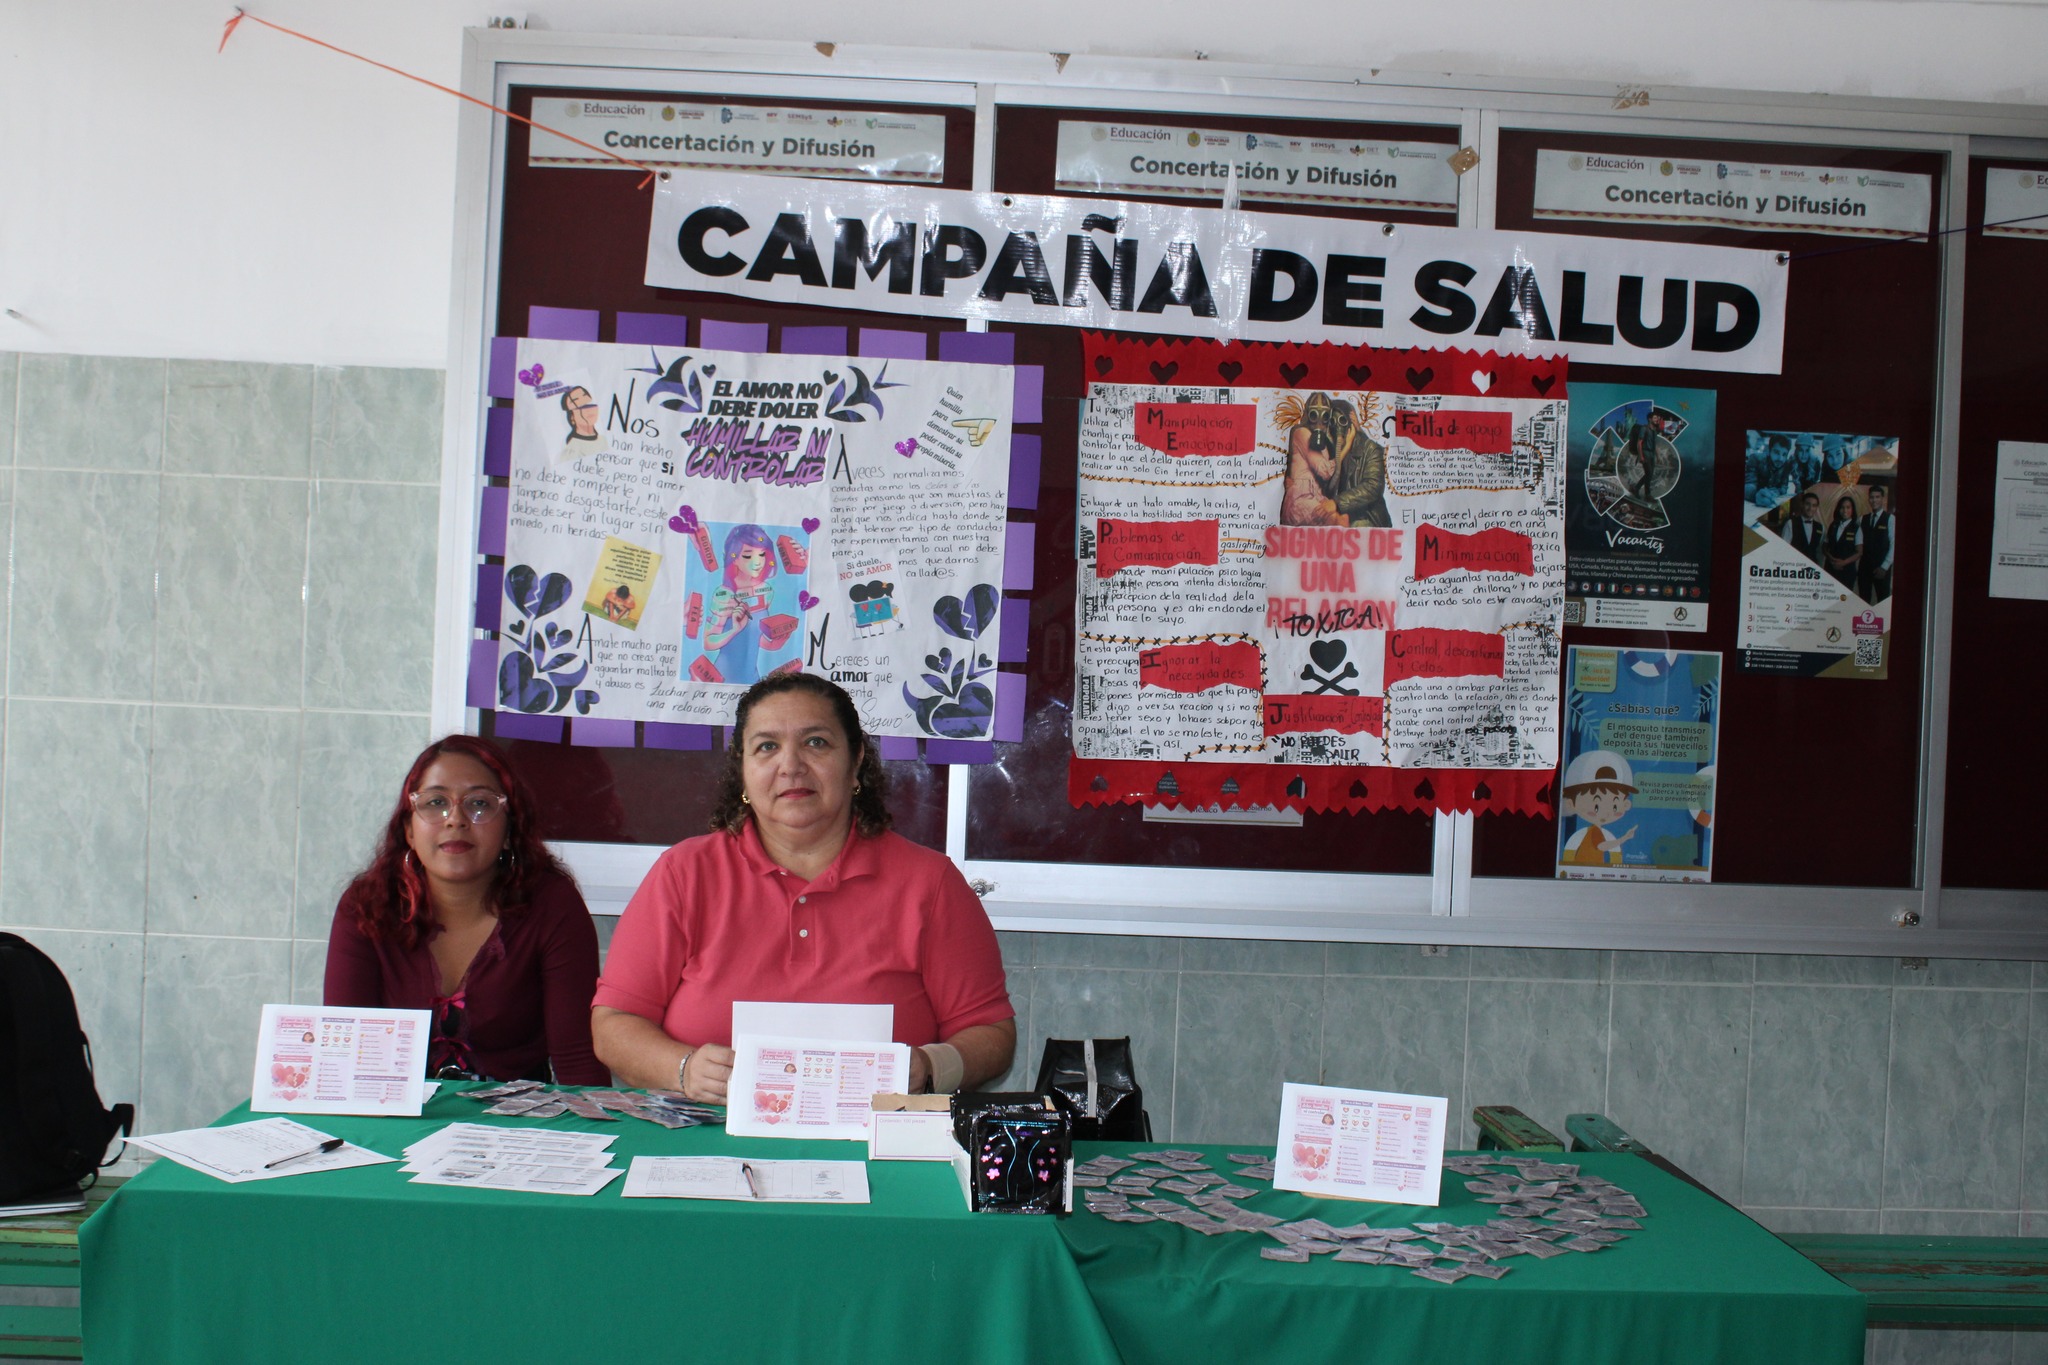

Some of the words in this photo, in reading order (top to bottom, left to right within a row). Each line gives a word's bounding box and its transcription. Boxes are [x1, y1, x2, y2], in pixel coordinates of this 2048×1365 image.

[584, 103, 645, 115] Educación
[1110, 127, 1171, 140] Educación
[604, 130, 754, 154] Concertación
[762, 140, 775, 158] y
[782, 137, 875, 158] Difusión
[1586, 156, 1644, 170] Educación
[1130, 155, 1279, 181] Concertación
[1286, 169, 1299, 185] y
[1307, 166, 1397, 188] Difusión
[1605, 185, 1748, 210] Concertación
[1755, 198, 1768, 214] y
[1775, 195, 1866, 217] Difusión
[677, 205, 1219, 319] CAMPAÑA
[1248, 248, 1386, 330] DE
[1409, 258, 1761, 353] SALUD
[713, 381, 733, 396] EL
[736, 382, 794, 398] AMOR
[797, 383, 822, 399] NO
[947, 386, 963, 401] Quien
[608, 378, 660, 438] Nos
[708, 400, 757, 417] DEBE
[758, 402, 818, 418] DOLER
[940, 398, 963, 415] humilla
[932, 409, 949, 422] para
[1083, 416, 1109, 428] utiliza
[1148, 408, 1233, 429] Manipulación
[927, 420, 956, 440] demostrar
[1403, 414, 1443, 437] Falta
[1448, 421, 1459, 434] de
[1466, 424, 1503, 443] apoyo
[681, 417, 802, 454] HUMILLAR
[806, 427, 832, 458] NI
[920, 431, 938, 444] poder
[1167, 432, 1238, 451] Emocional
[612, 436, 632, 450] han
[640, 442, 672, 459] hecho
[596, 453, 632, 467] pensar
[574, 459, 610, 482] duele,
[613, 472, 638, 485] pero
[657, 480, 686, 492] amor
[685, 450, 826, 488] CONTROLAR
[893, 467, 964, 479] normalizamos
[1221, 471, 1257, 480] control
[516, 468, 531, 480] no
[537, 469, 566, 485] debe
[832, 484, 874, 492] conductas
[864, 494, 905, 503] pensando
[602, 511, 633, 534] lugar
[640, 520, 664, 534] sin
[933, 512, 957, 520] hasta
[864, 524, 896, 533] tolerar
[957, 523, 1002, 532] conductas
[1443, 519, 1478, 528] normal
[1485, 520, 1506, 529] pero
[568, 525, 608, 540] heridas
[851, 533, 928, 546] experimentamos
[953, 533, 989, 542] nuestra
[1101, 521, 1163, 544] Problemas
[1172, 532, 1184, 542] de
[1516, 531, 1558, 539] relacion
[1219, 538, 1267, 557] gaslighting
[1265, 527, 1361, 558] SIGNOS
[1369, 529, 1403, 560] DE
[1606, 529, 1664, 554] Vacantes
[832, 548, 863, 559] pareja
[856, 558, 882, 568] duele,
[840, 571, 853, 580] NO
[855, 569, 865, 577] es
[866, 563, 892, 575] AMOR
[1150, 567, 1214, 576] manipulación
[1301, 562, 1356, 593] UNA
[1750, 566, 1821, 579] Graduados
[1462, 597, 1481, 605] solo
[621, 638, 651, 650] mucho
[656, 642, 677, 653] para
[631, 654, 654, 662] creas
[876, 655, 889, 665] un
[1209, 651, 1221, 665] la
[594, 665, 633, 679] aguantar
[637, 665, 677, 677] maltratos
[830, 671, 873, 682] amor
[875, 673, 893, 684] que
[605, 678, 631, 689] abusos
[1390, 679, 1422, 691] Cuando
[1490, 685, 1518, 695] partes
[692, 689, 708, 700] por
[1396, 693, 1448, 702] controlando
[672, 701, 712, 714] relación
[1618, 724, 1658, 735] mosquito
[1662, 725, 1706, 734] transmisor
[1630, 733, 1661, 742] dengue
[1604, 740, 1641, 750] deposita
[1661, 742, 1708, 750] huevecillos
[1652, 749, 1687, 758] albercas
